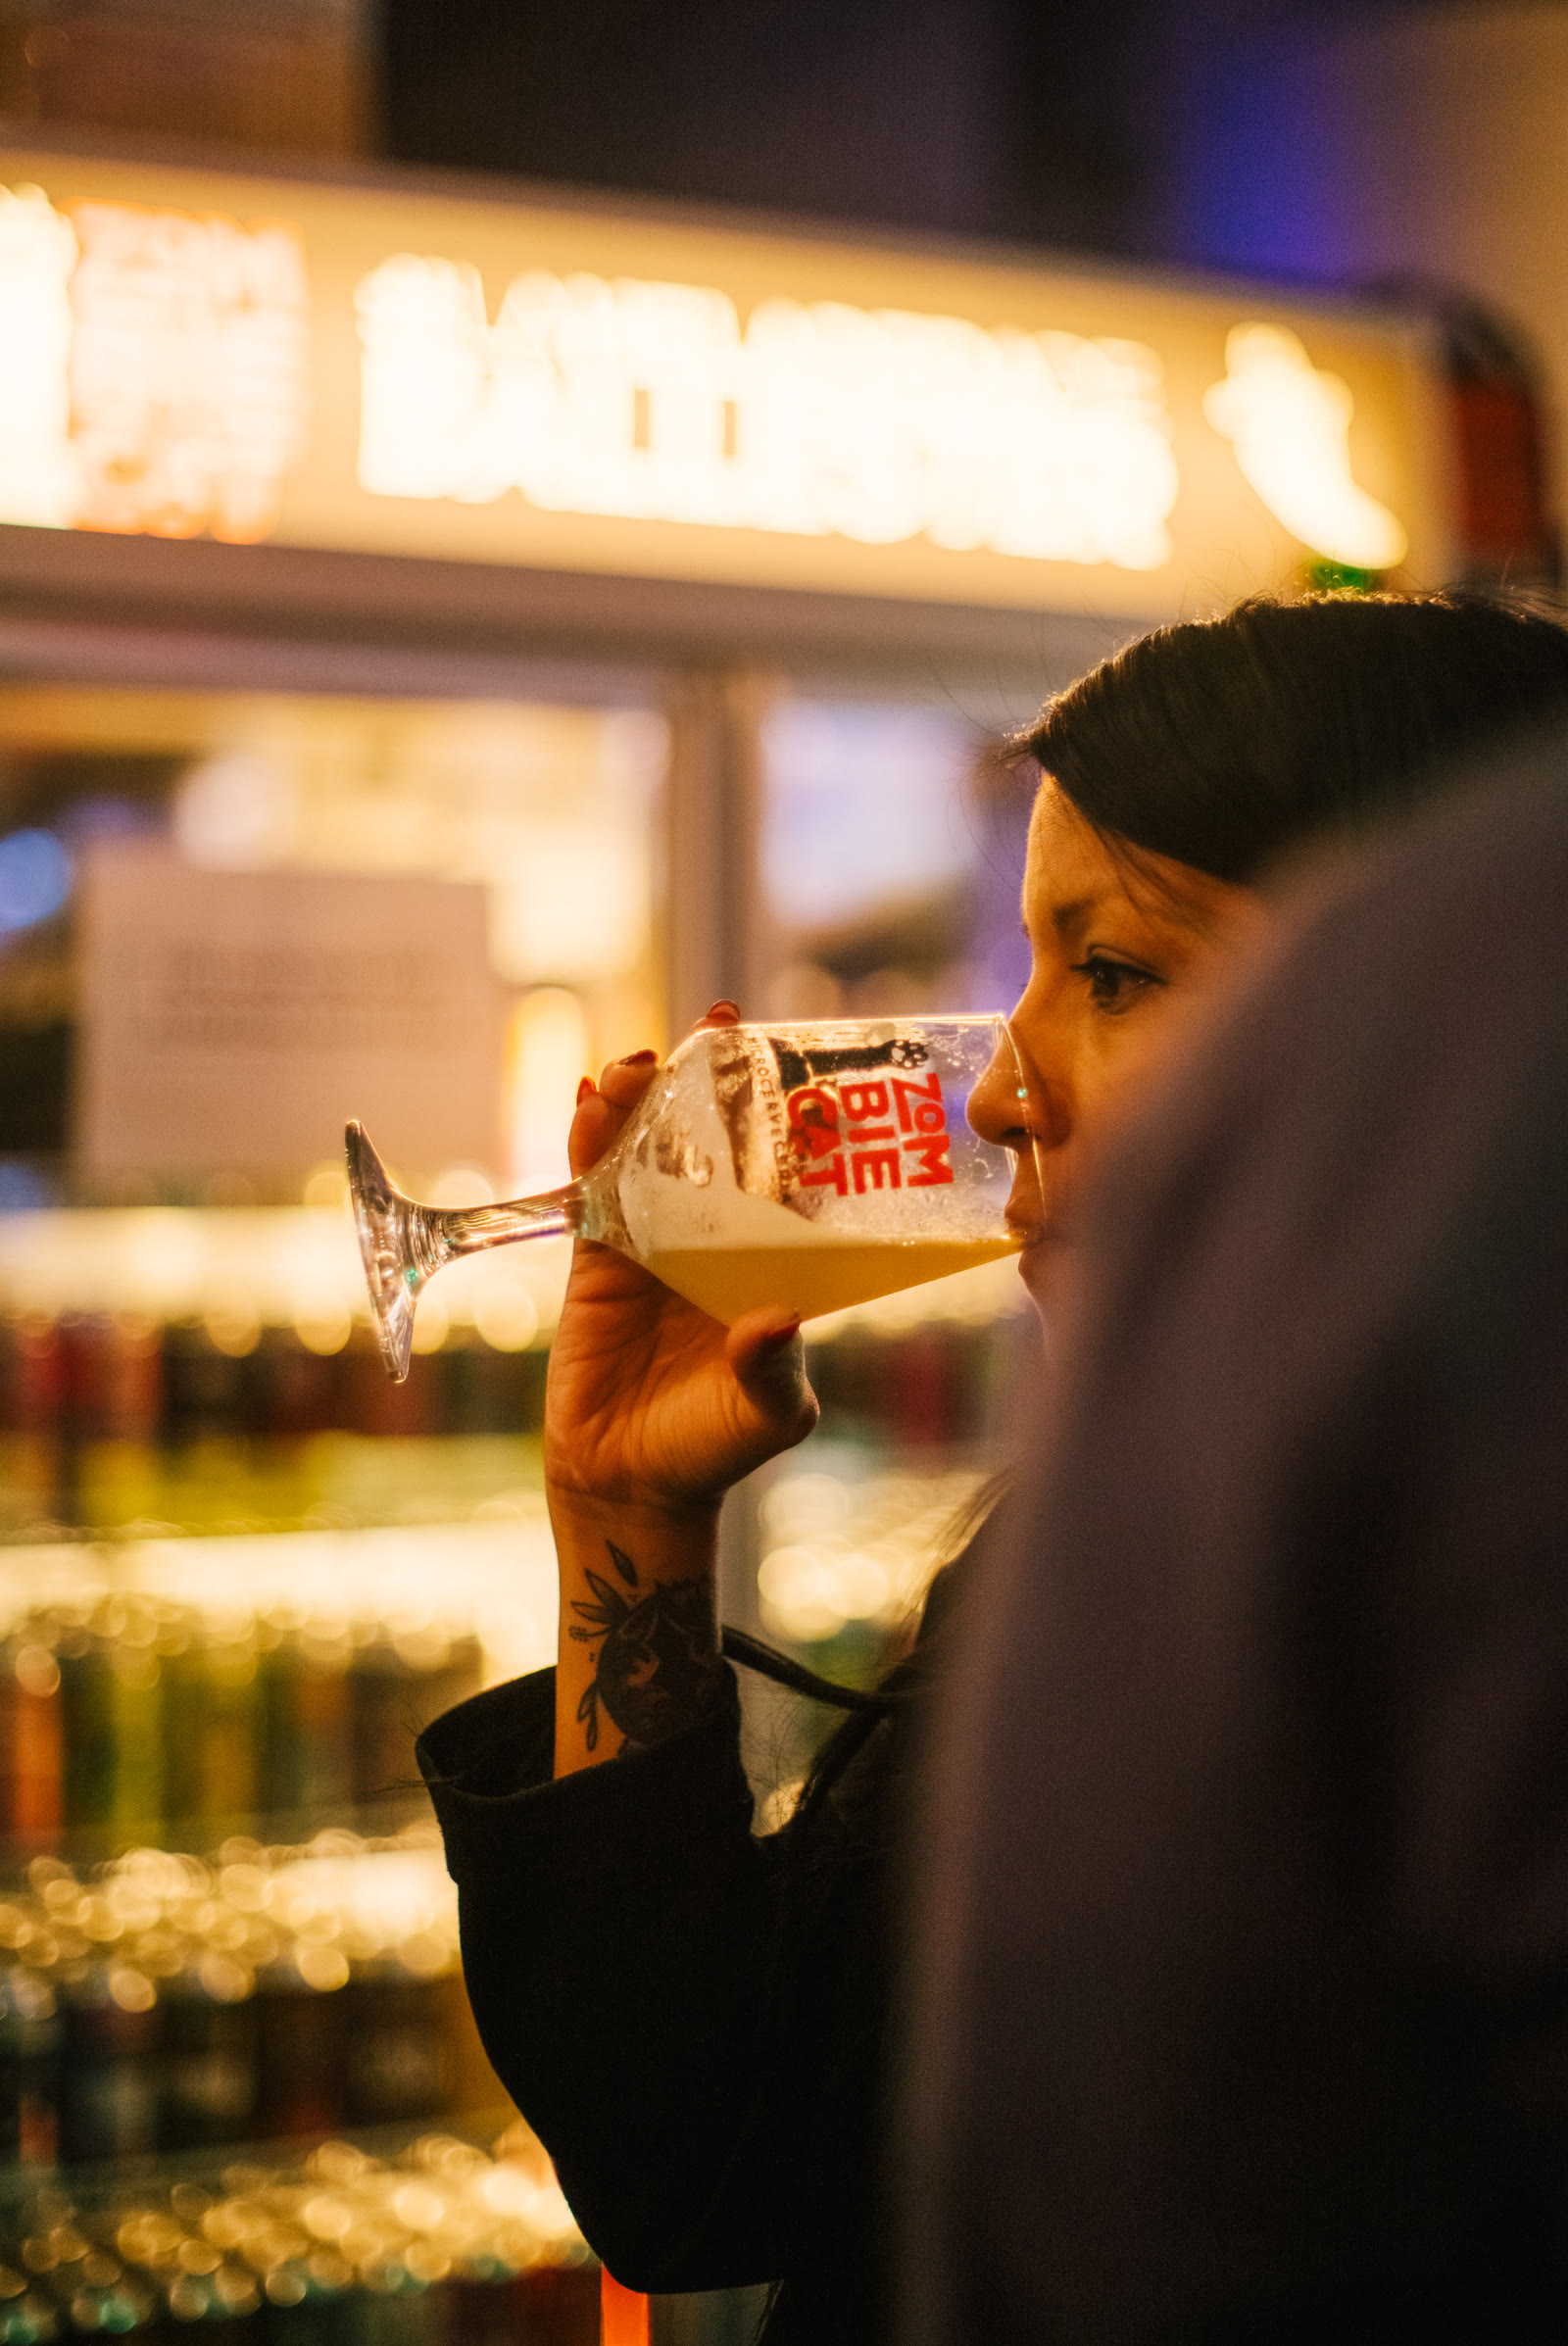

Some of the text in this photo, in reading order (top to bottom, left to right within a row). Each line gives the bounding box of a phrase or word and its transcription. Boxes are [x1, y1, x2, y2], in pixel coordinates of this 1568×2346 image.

[787, 1088, 849, 1197] CAT
[839, 1080, 901, 1195] BIE
[891, 1073, 955, 1188] ZOM
